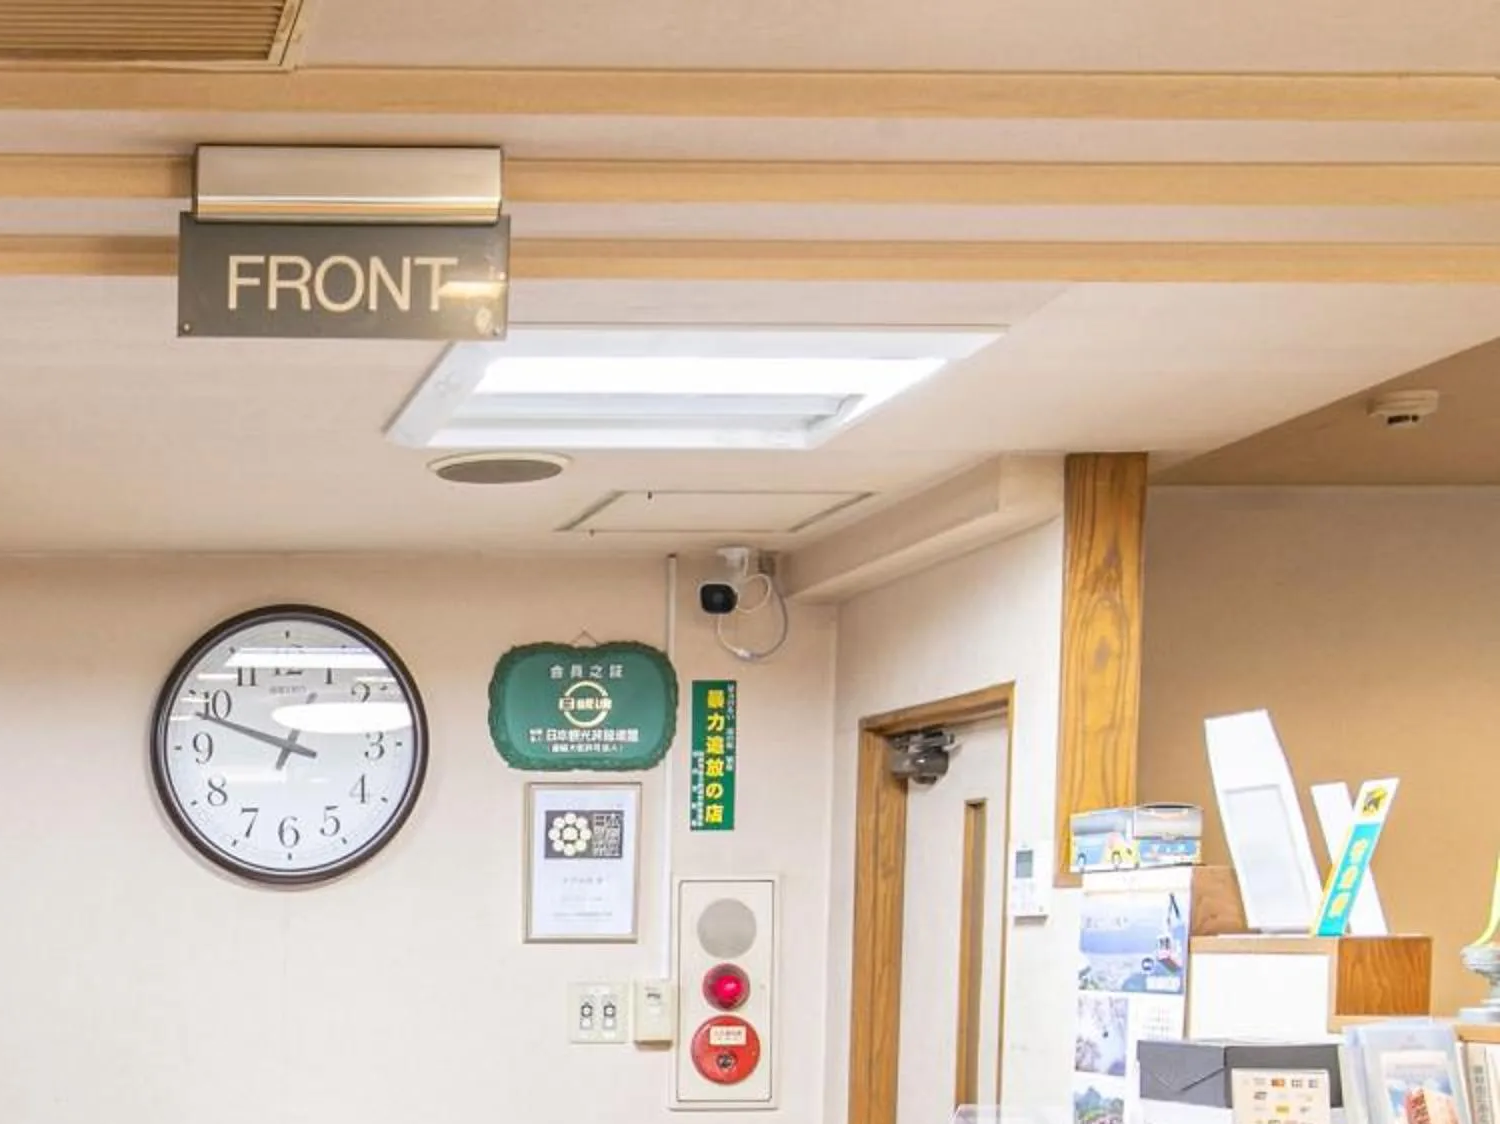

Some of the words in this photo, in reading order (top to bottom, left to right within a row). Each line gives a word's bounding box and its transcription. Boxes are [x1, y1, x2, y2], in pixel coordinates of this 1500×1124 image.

[227, 254, 459, 312] FRONT
[200, 688, 232, 722] 10
[192, 731, 214, 765] 9
[364, 730, 386, 761] 3
[206, 773, 228, 807] 8
[348, 773, 371, 805] 4
[240, 807, 260, 839] 7
[277, 815, 301, 849] 6
[319, 804, 341, 838] 5
